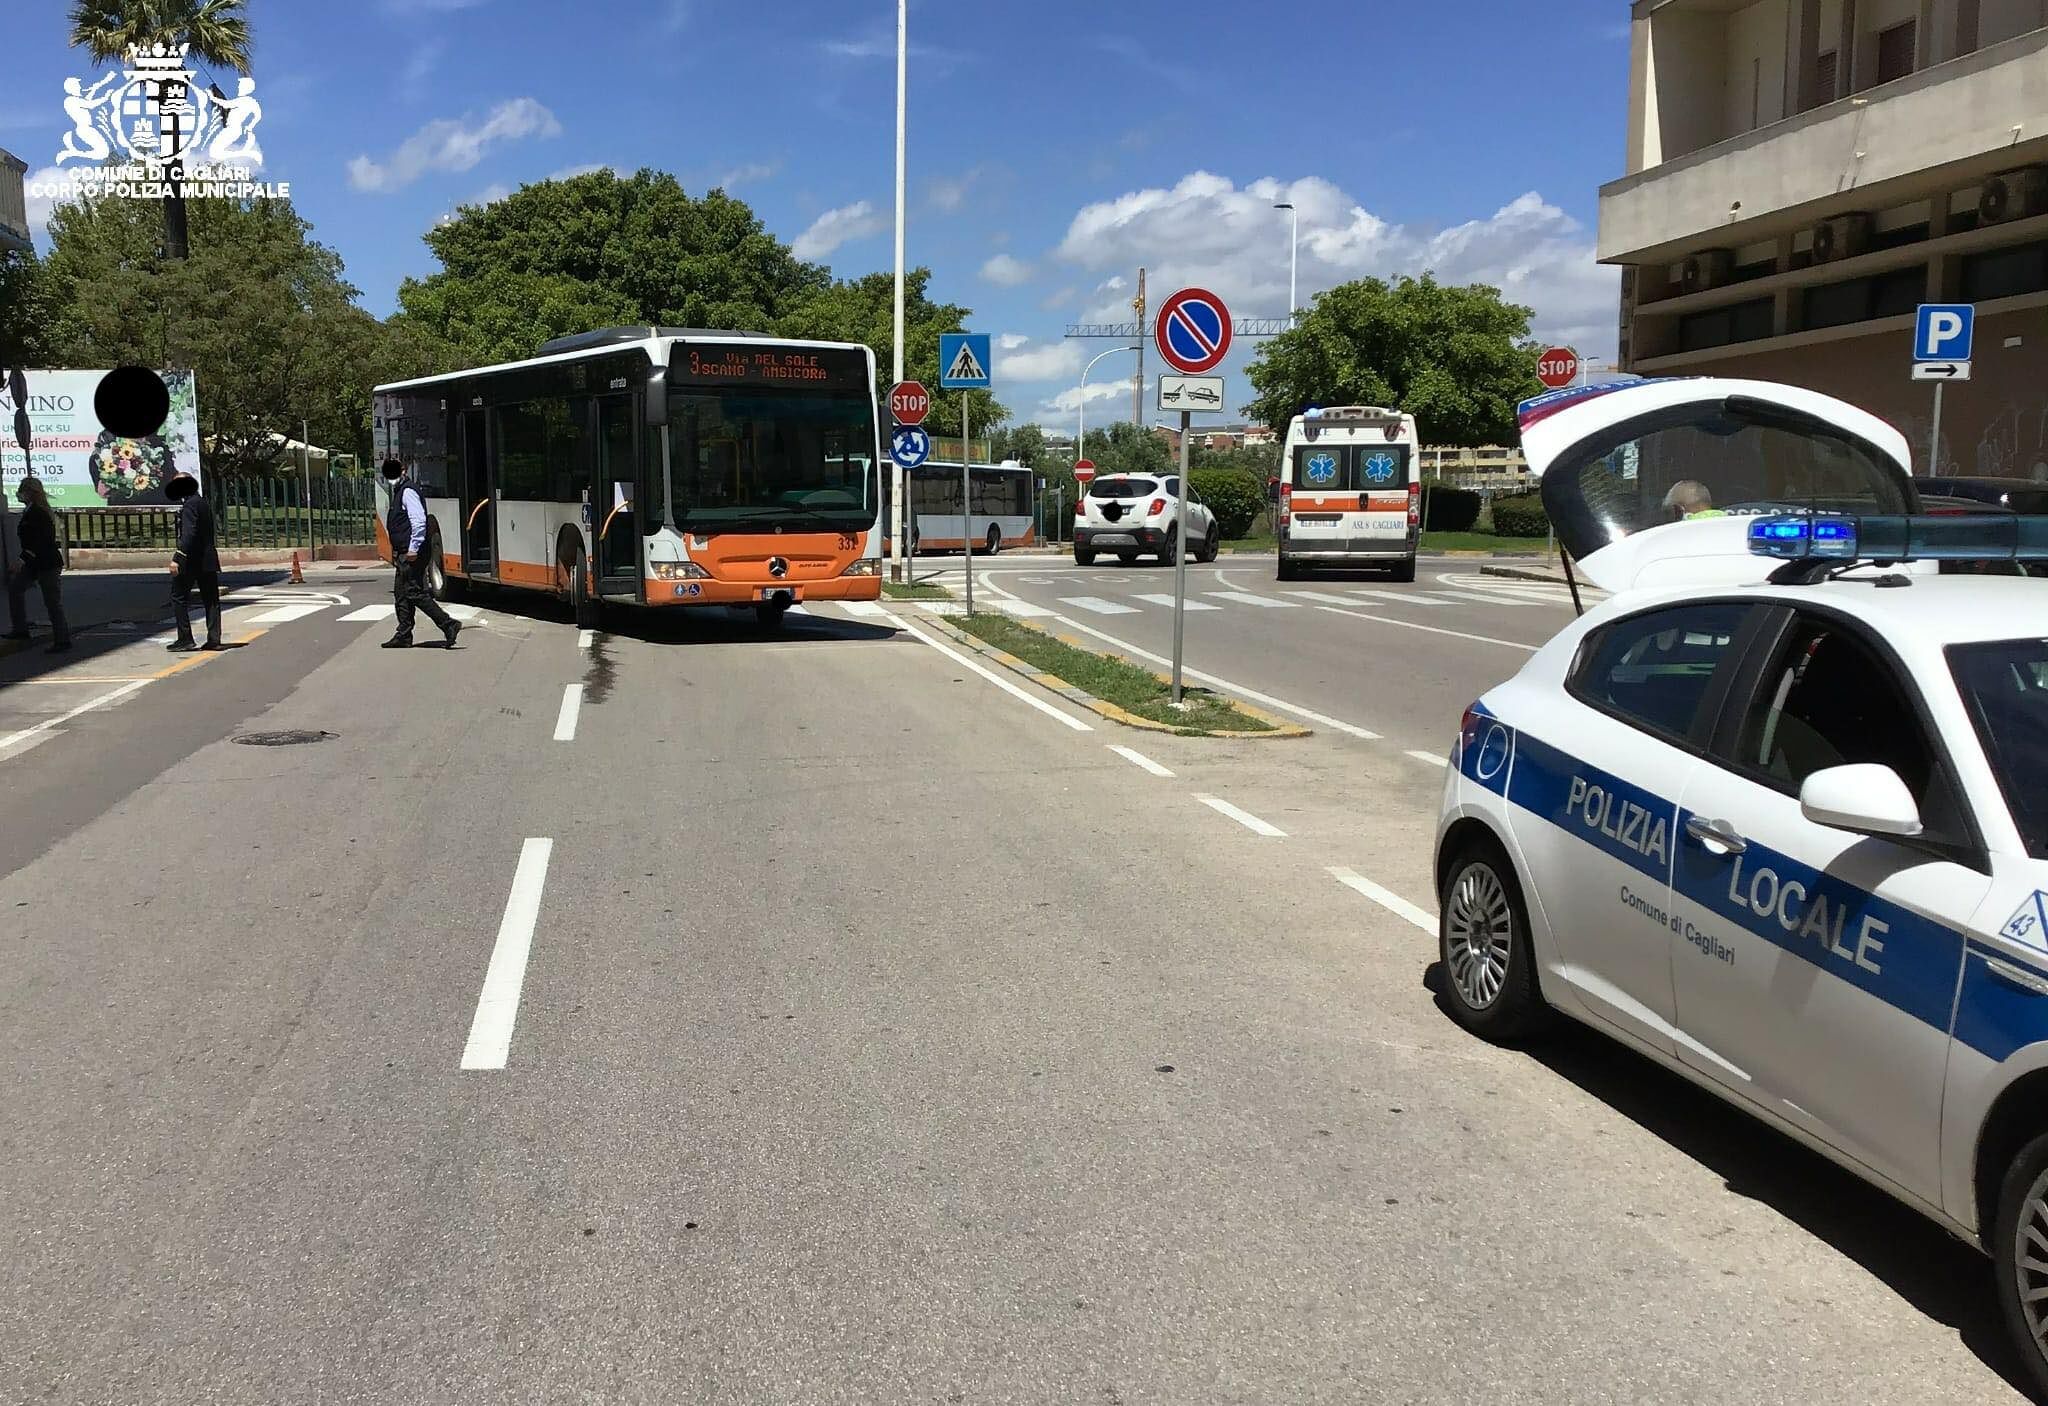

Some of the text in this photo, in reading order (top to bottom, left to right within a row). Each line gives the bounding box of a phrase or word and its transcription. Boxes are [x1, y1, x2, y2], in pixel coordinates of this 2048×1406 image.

[1927, 312, 1962, 354] P
[690, 351, 700, 374] 3
[755, 354, 780, 366] DEL
[785, 355, 818, 367] SOLE
[1539, 359, 1575, 376] STOP
[0, 395, 74, 411] NINO
[893, 394, 927, 412] STOP
[56, 424, 70, 433] SU
[43, 464, 64, 475] 103
[1567, 776, 1667, 865] POLIZIA
[1619, 885, 1737, 967] Comune di Cagliari
[1729, 856, 1891, 976] LOCALE
[2009, 913, 2037, 937] 43
